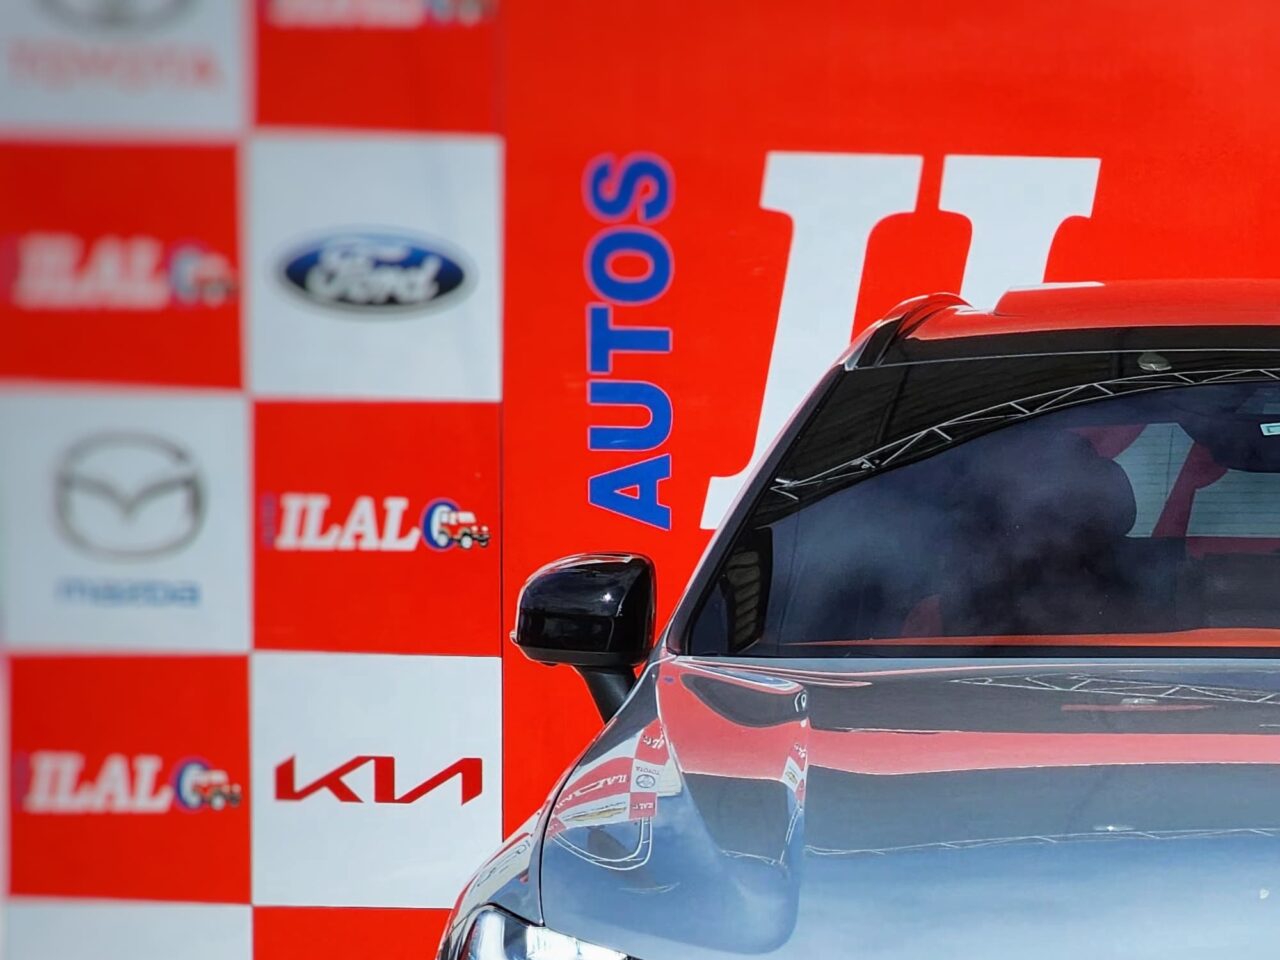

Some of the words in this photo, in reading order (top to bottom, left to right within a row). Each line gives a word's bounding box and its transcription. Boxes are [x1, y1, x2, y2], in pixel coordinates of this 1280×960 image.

[303, 243, 442, 305] Ford
[583, 152, 675, 531] AUTOS
[275, 755, 484, 806] KIA
